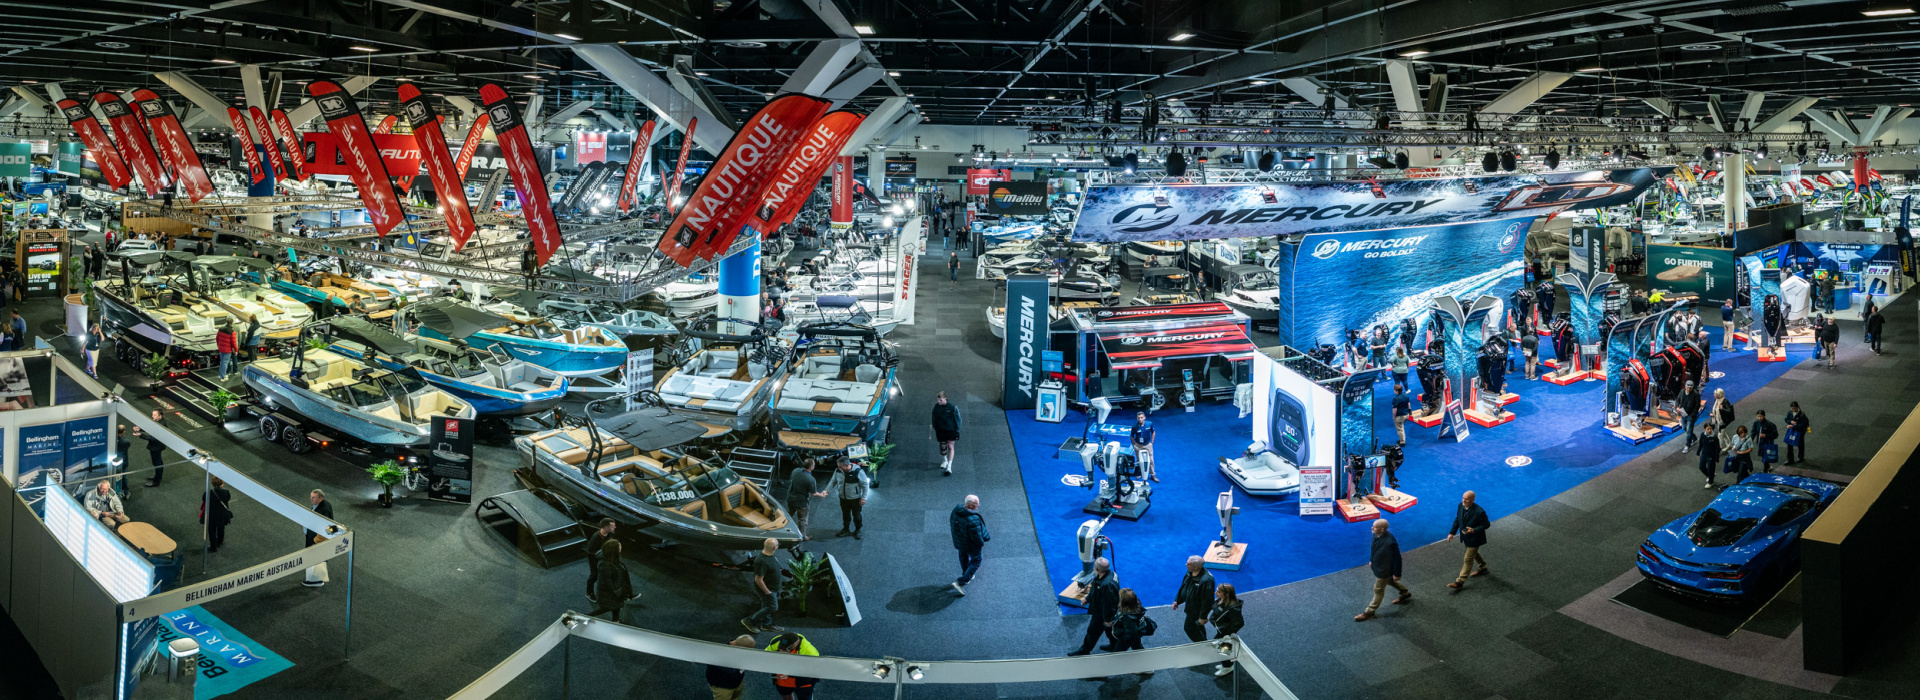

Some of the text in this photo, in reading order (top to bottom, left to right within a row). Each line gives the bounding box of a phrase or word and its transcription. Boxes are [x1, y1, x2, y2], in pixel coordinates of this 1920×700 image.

[625, 130, 649, 193] NAUTIQUE
[687, 113, 783, 231] NAUTIQUE
[766, 123, 835, 209] NAUTIQUE
[563, 168, 593, 205] BAR CRUSHER
[589, 167, 609, 191] CRUSHER
[1002, 194, 1043, 203] Malibu
[1189, 199, 1445, 225] MERCURY
[1340, 234, 1429, 253] MERCURY
[1664, 257, 1714, 269] GO FURTHER
[901, 255, 912, 301] STACER
[1018, 295, 1035, 399] MERCURY
[1146, 331, 1225, 343] MERCURY
[26, 435, 59, 443] Bellingham
[71, 428, 103, 437] Bellingham
[72, 435, 101, 443] MARINE
[27, 442, 57, 450] MARINE
[656, 490, 695, 502] $138,000
[185, 556, 303, 603] BELLINGHAM MARINE AUSTRALIA
[129, 608, 135, 617] 4
[172, 613, 252, 664] MARINE
